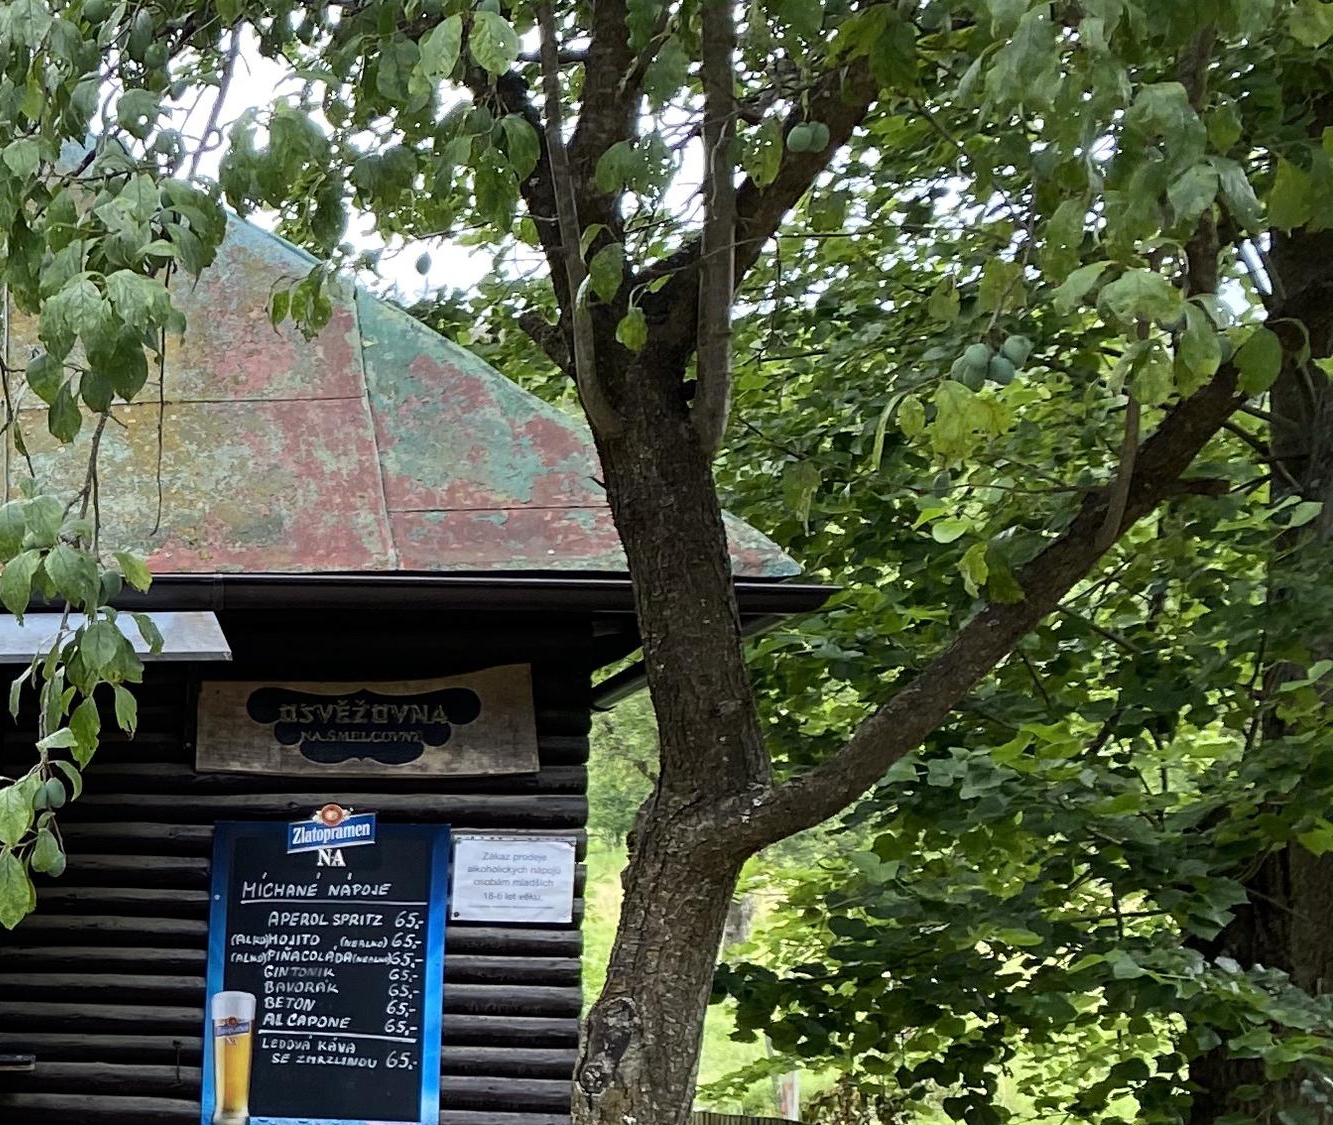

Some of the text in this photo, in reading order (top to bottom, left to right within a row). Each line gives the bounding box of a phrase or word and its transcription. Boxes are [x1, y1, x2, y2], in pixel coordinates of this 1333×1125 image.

[278, 699, 449, 724] OSVĚŽOVNA
[292, 823, 371, 845] Zlatopramen
[242, 872, 391, 898] MÍCHANÉ NÁPOJE
[268, 911, 329, 927] APEROL
[333, 913, 383, 927] SPRITZ
[264, 996, 316, 1012] BETON
[262, 1013, 283, 1026] AL
[286, 1013, 351, 1029] CAPONE
[271, 1053, 290, 1064] SE
[296, 1055, 378, 1069] ZMRZLINOU
